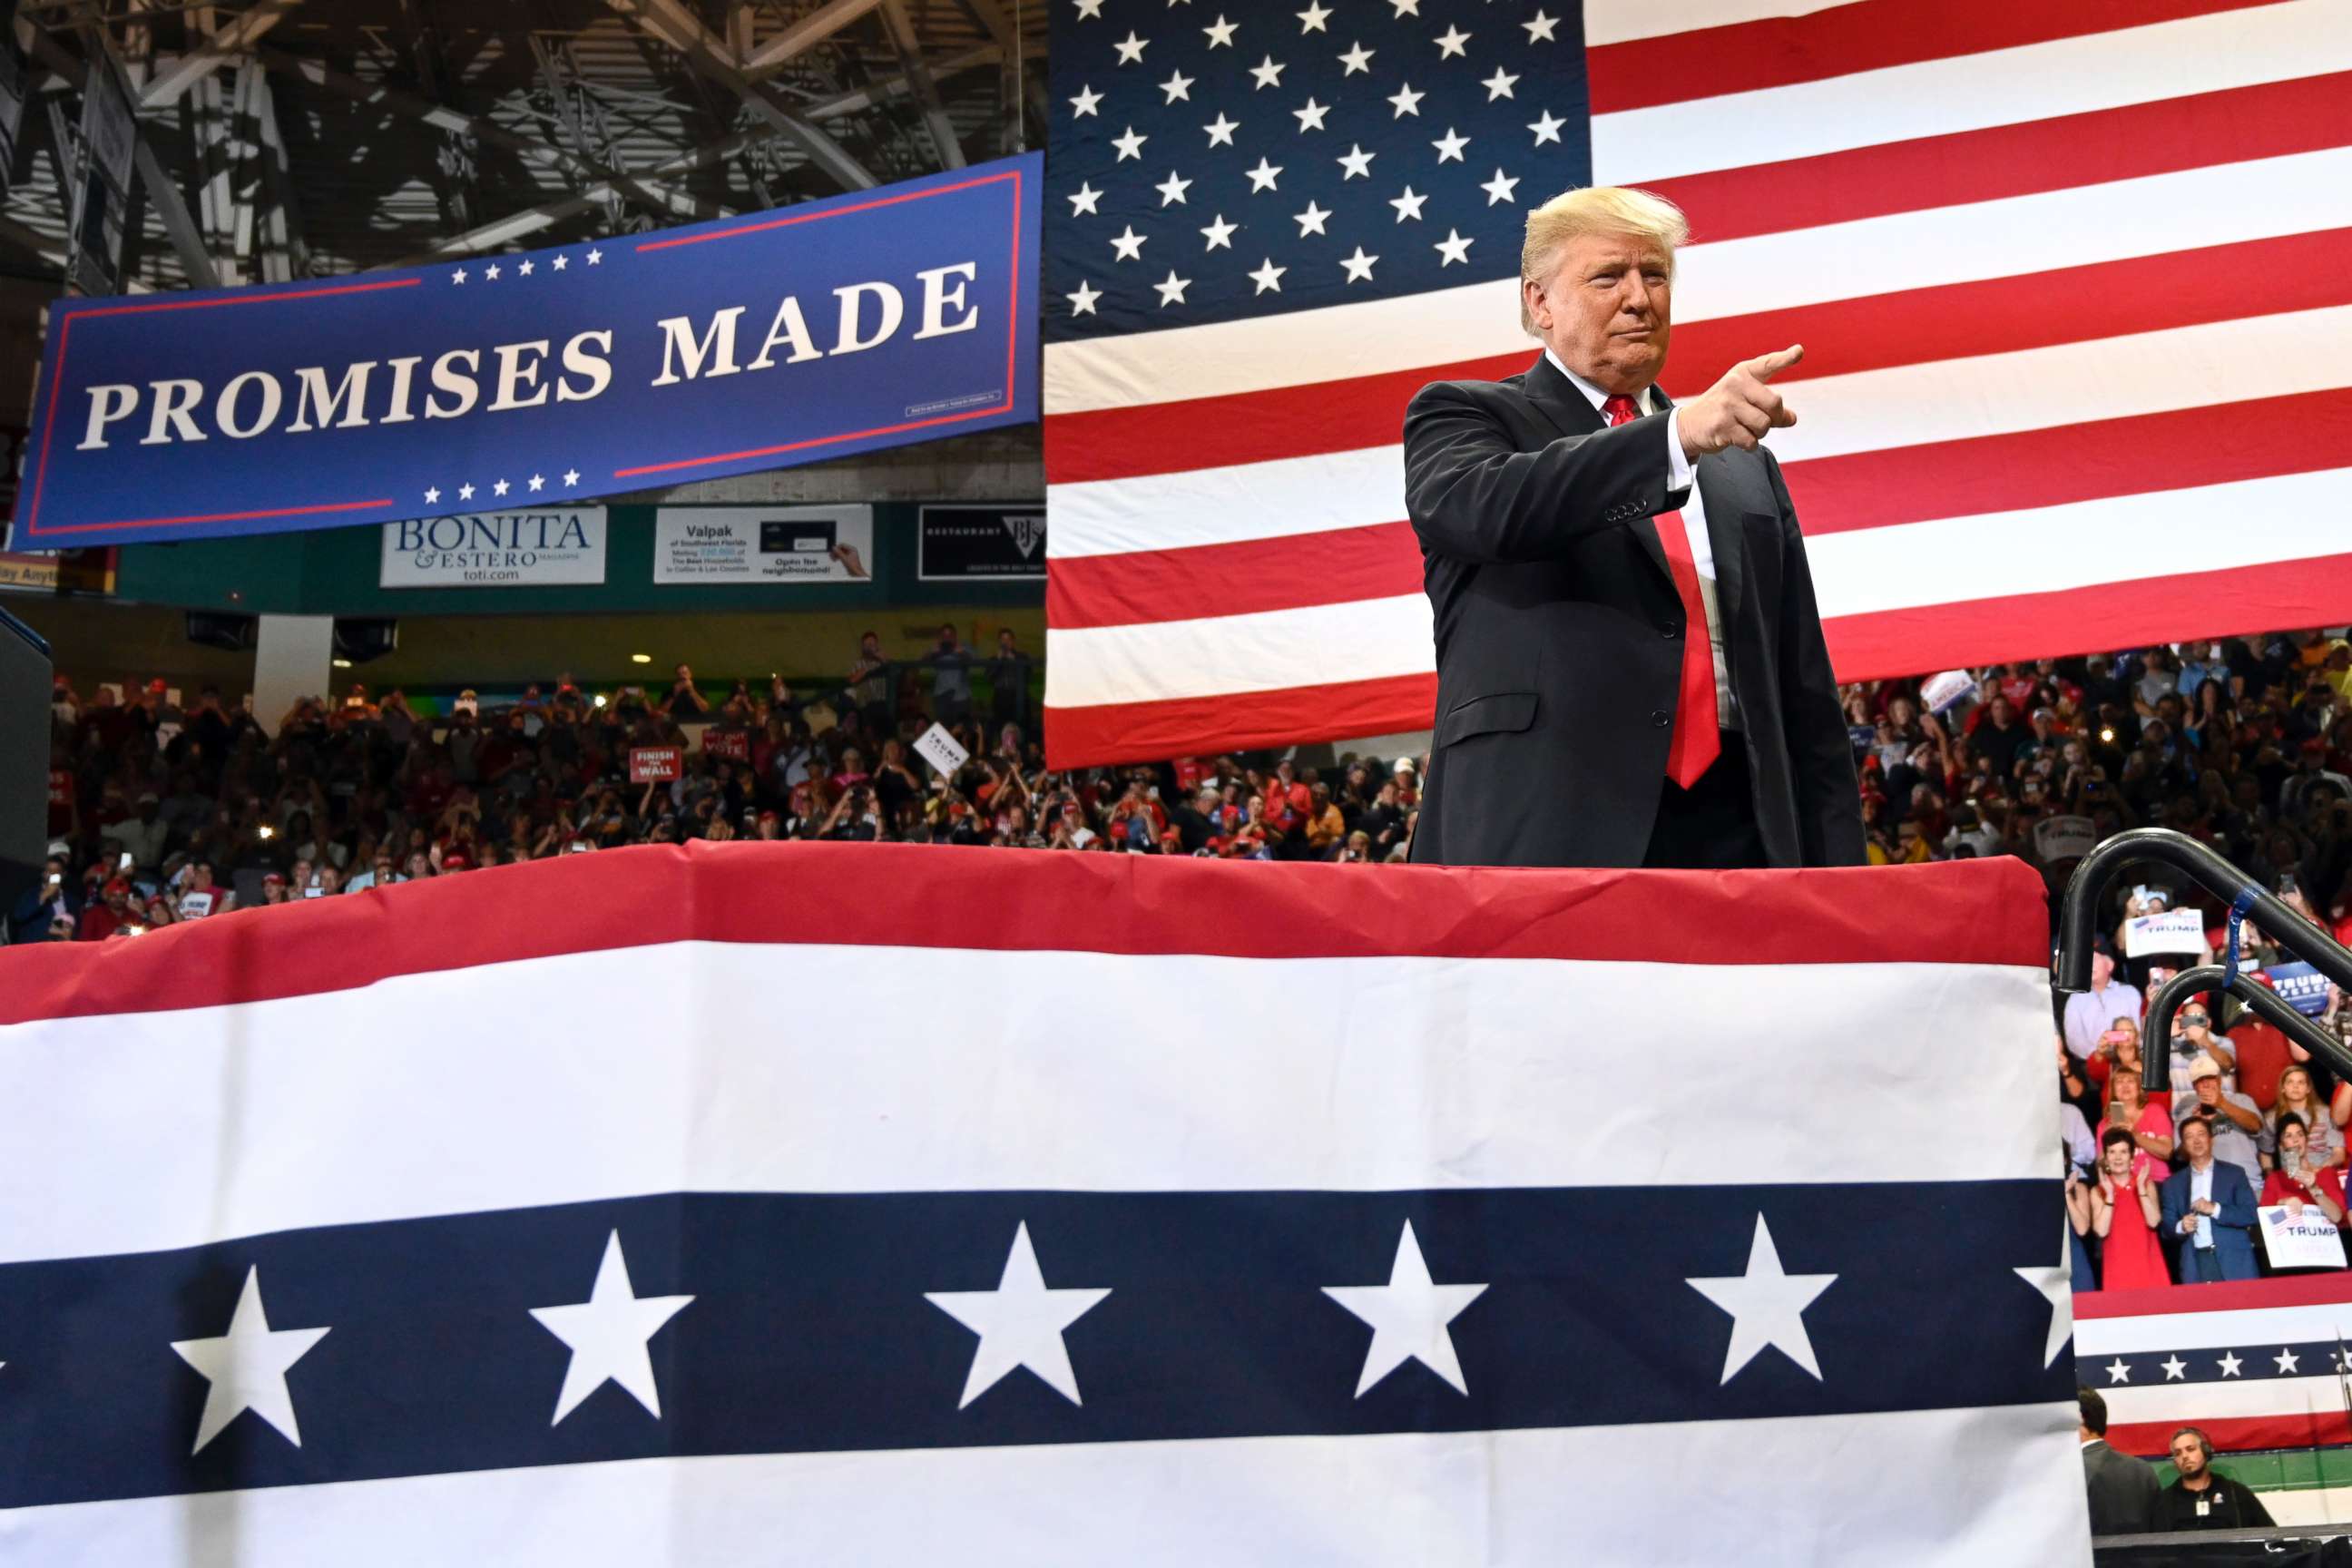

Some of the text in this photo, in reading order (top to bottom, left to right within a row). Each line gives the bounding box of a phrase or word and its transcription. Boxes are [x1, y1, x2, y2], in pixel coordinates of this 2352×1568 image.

[76, 260, 979, 451] PROMISES MADE
[394, 514, 593, 553] BONITA
[686, 524, 732, 539] Valpak
[926, 527, 1002, 536] RESTAURANT
[414, 549, 440, 569] &
[441, 551, 537, 569] ESTERO
[775, 558, 801, 566] Open
[464, 569, 520, 582] toti.com
[705, 740, 743, 755] VOTE
[637, 750, 674, 762] FINISH
[638, 766, 673, 777] WALL
[2147, 924, 2200, 935] TRUMP
[2287, 1226, 2337, 1237] TRUMP
